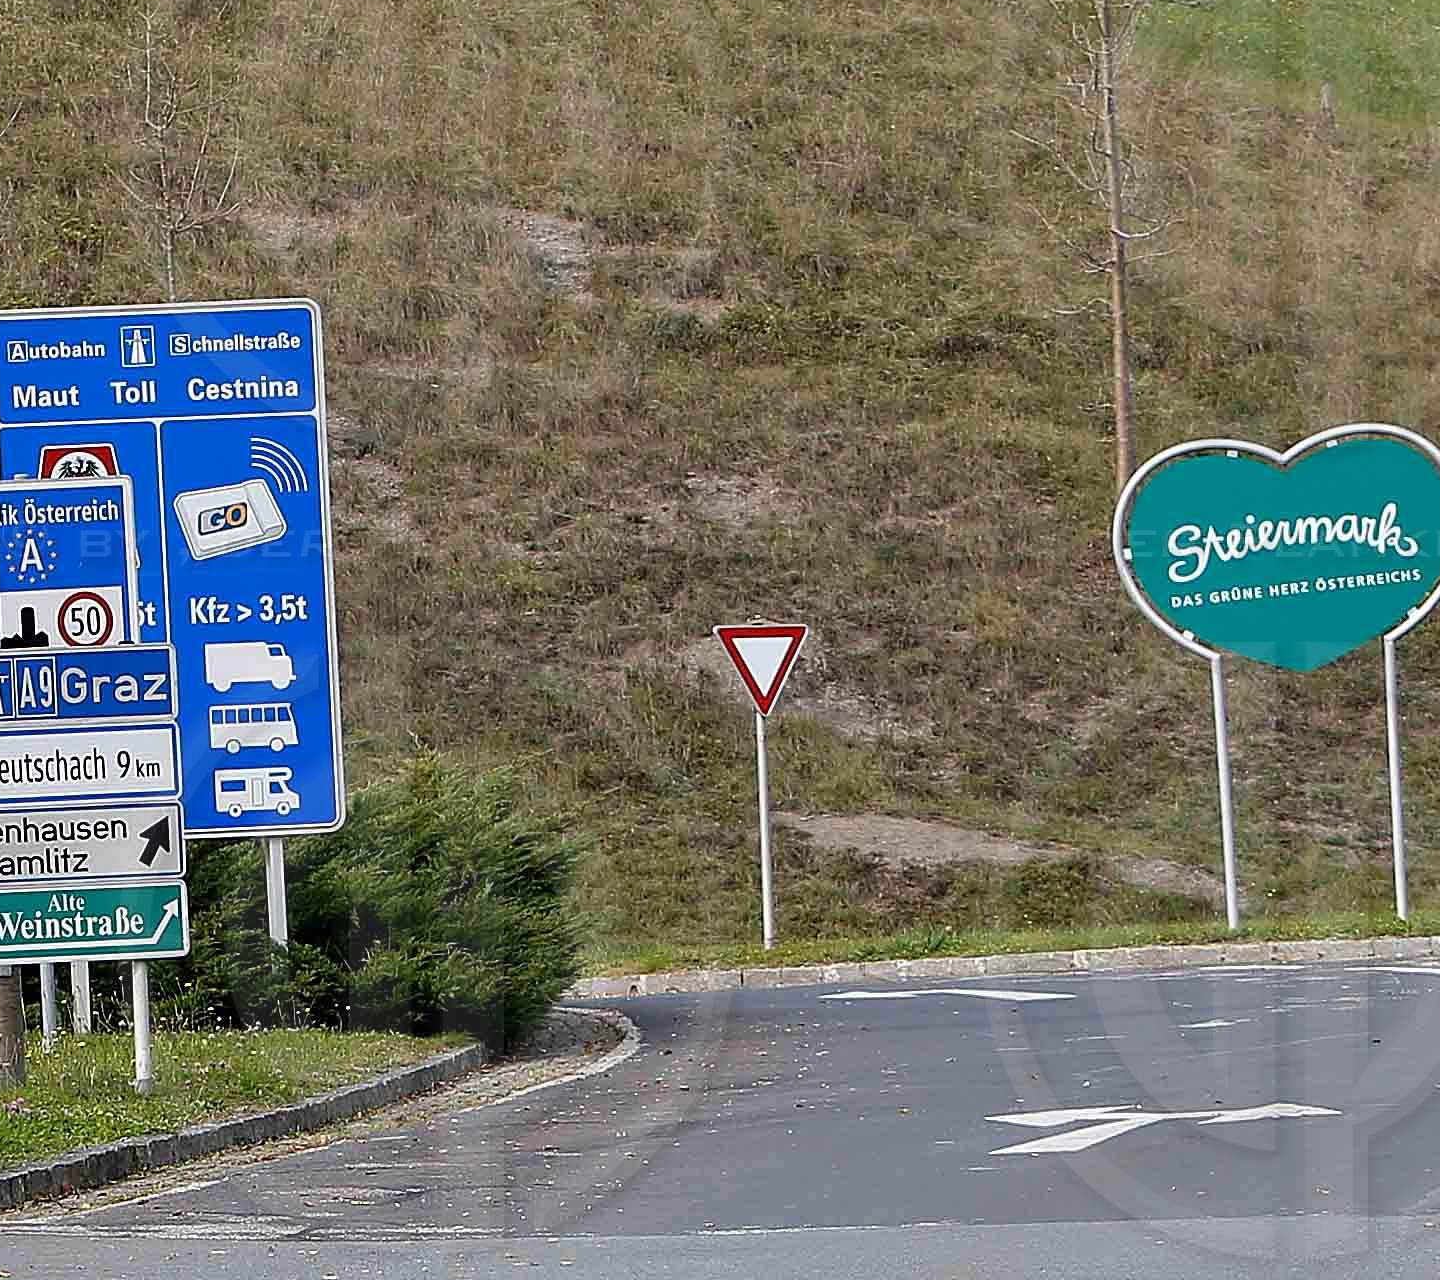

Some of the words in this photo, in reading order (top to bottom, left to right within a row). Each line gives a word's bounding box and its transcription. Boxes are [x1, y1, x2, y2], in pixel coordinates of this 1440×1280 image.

[10, 339, 106, 361] Autobahn
[173, 332, 301, 355] Schnellstraße
[13, 384, 80, 408] Maut
[110, 380, 157, 404] Toll
[188, 377, 299, 402] Cestnina
[24, 497, 119, 525] Österreich
[203, 501, 248, 534] GO
[19, 538, 45, 572] A
[1167, 501, 1419, 583] Steiermark
[1171, 592, 1203, 609] DAS
[1209, 585, 1263, 604] GRÜNE
[1269, 580, 1310, 598] HERZ
[1315, 567, 1422, 593] ÖSTERREICHS
[71, 606, 102, 637] 50
[190, 596, 231, 625] Kfz
[259, 594, 308, 626] 3,5t
[19, 665, 53, 709] A9
[60, 665, 168, 708] Graz
[118, 749, 132, 779] 9
[135, 758, 161, 779] km
[47, 893, 85, 913] Alte
